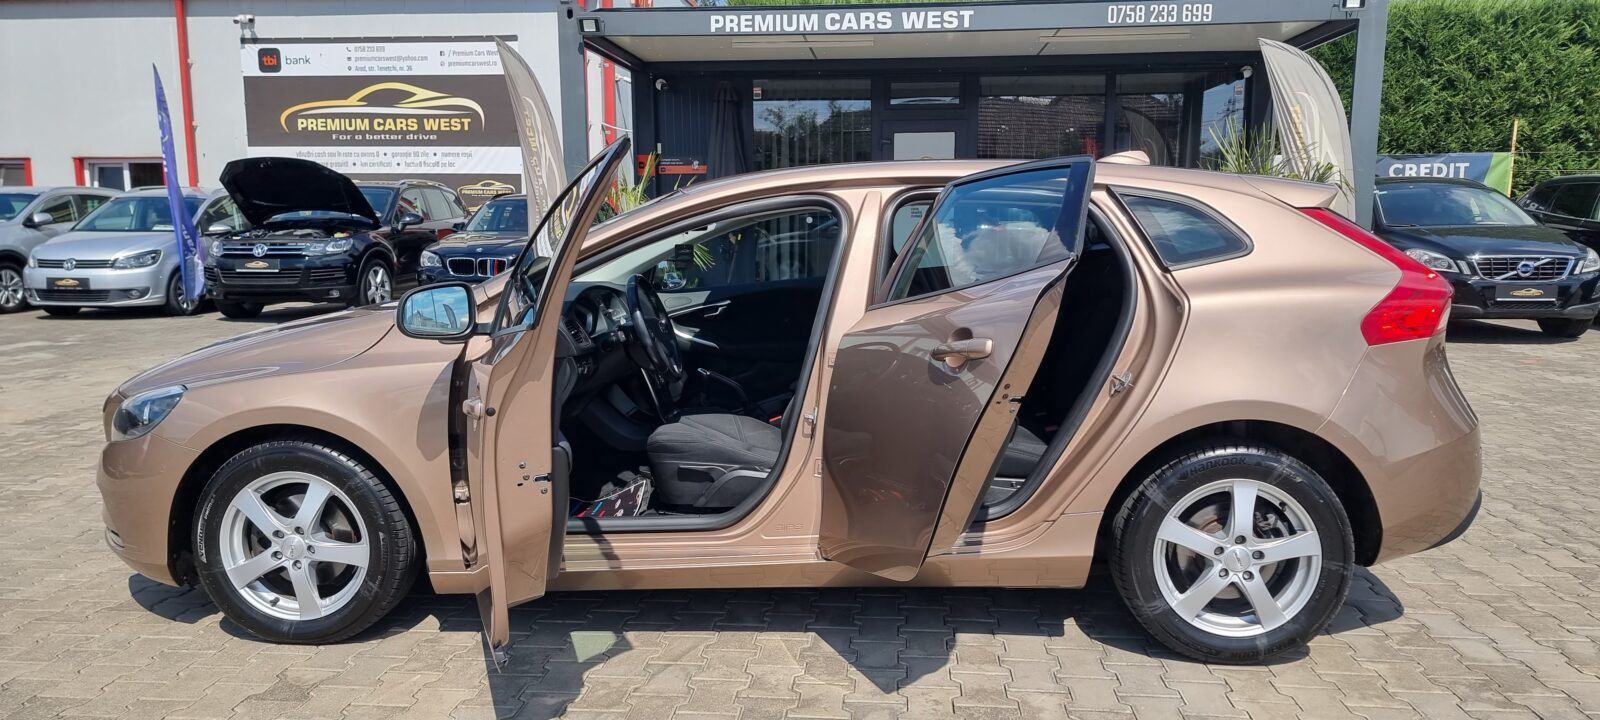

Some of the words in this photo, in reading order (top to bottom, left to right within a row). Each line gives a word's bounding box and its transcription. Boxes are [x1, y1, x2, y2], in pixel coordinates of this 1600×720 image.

[1107, 5, 1145, 24] 0758
[1150, 4, 1178, 23] 233
[1182, 3, 1213, 22] 699
[710, 13, 819, 33] PREMIUM
[824, 11, 893, 31] CARS
[901, 10, 975, 30] WEST
[263, 55, 277, 66] tbi
[285, 55, 311, 65] bank
[297, 118, 370, 131] PREMIUM
[373, 118, 418, 131] CARS
[423, 118, 472, 131] WEST
[405, 132, 437, 140] drive
[1388, 162, 1470, 179] CREDIT
